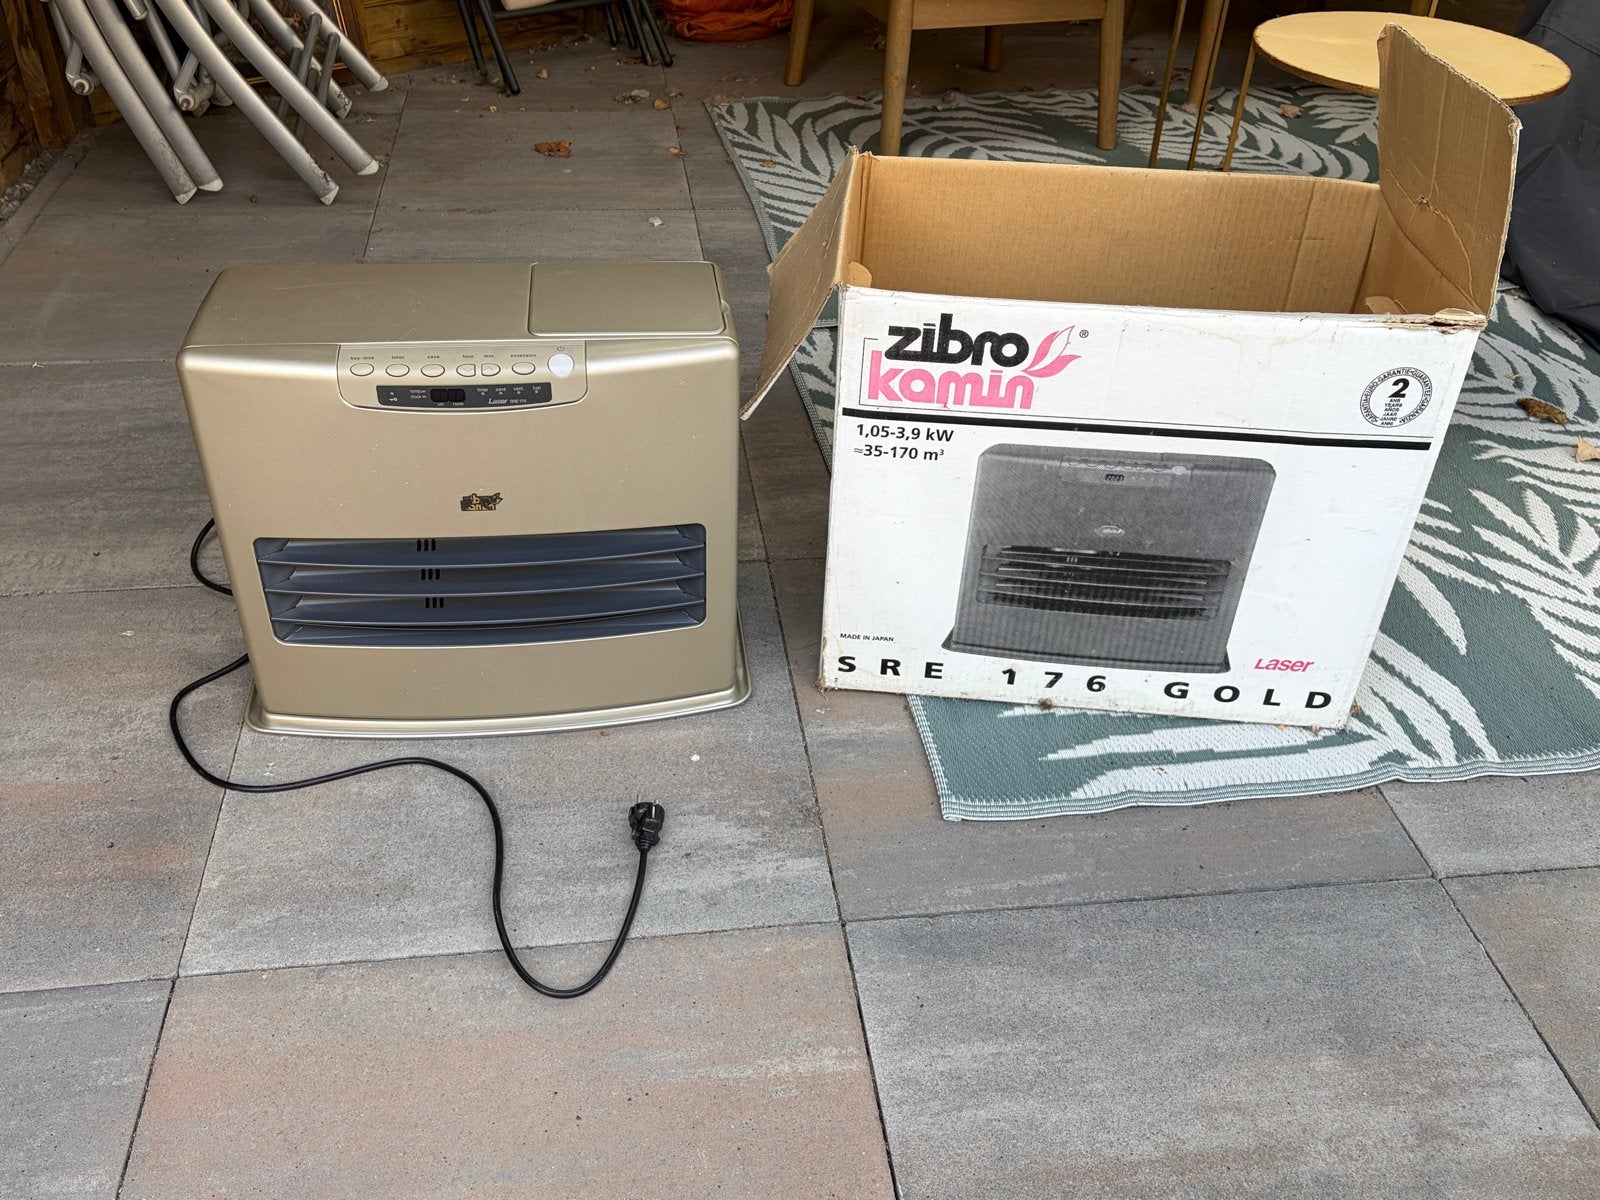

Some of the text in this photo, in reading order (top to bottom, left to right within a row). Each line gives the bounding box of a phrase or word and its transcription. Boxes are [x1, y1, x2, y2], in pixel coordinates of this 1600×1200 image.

[884, 312, 1030, 368] zibro
[867, 350, 1035, 410] kamin
[1387, 378, 1410, 398] 2
[856, 423, 954, 442] 1,05-3,9 kW
[1254, 658, 1315, 673] Laser
